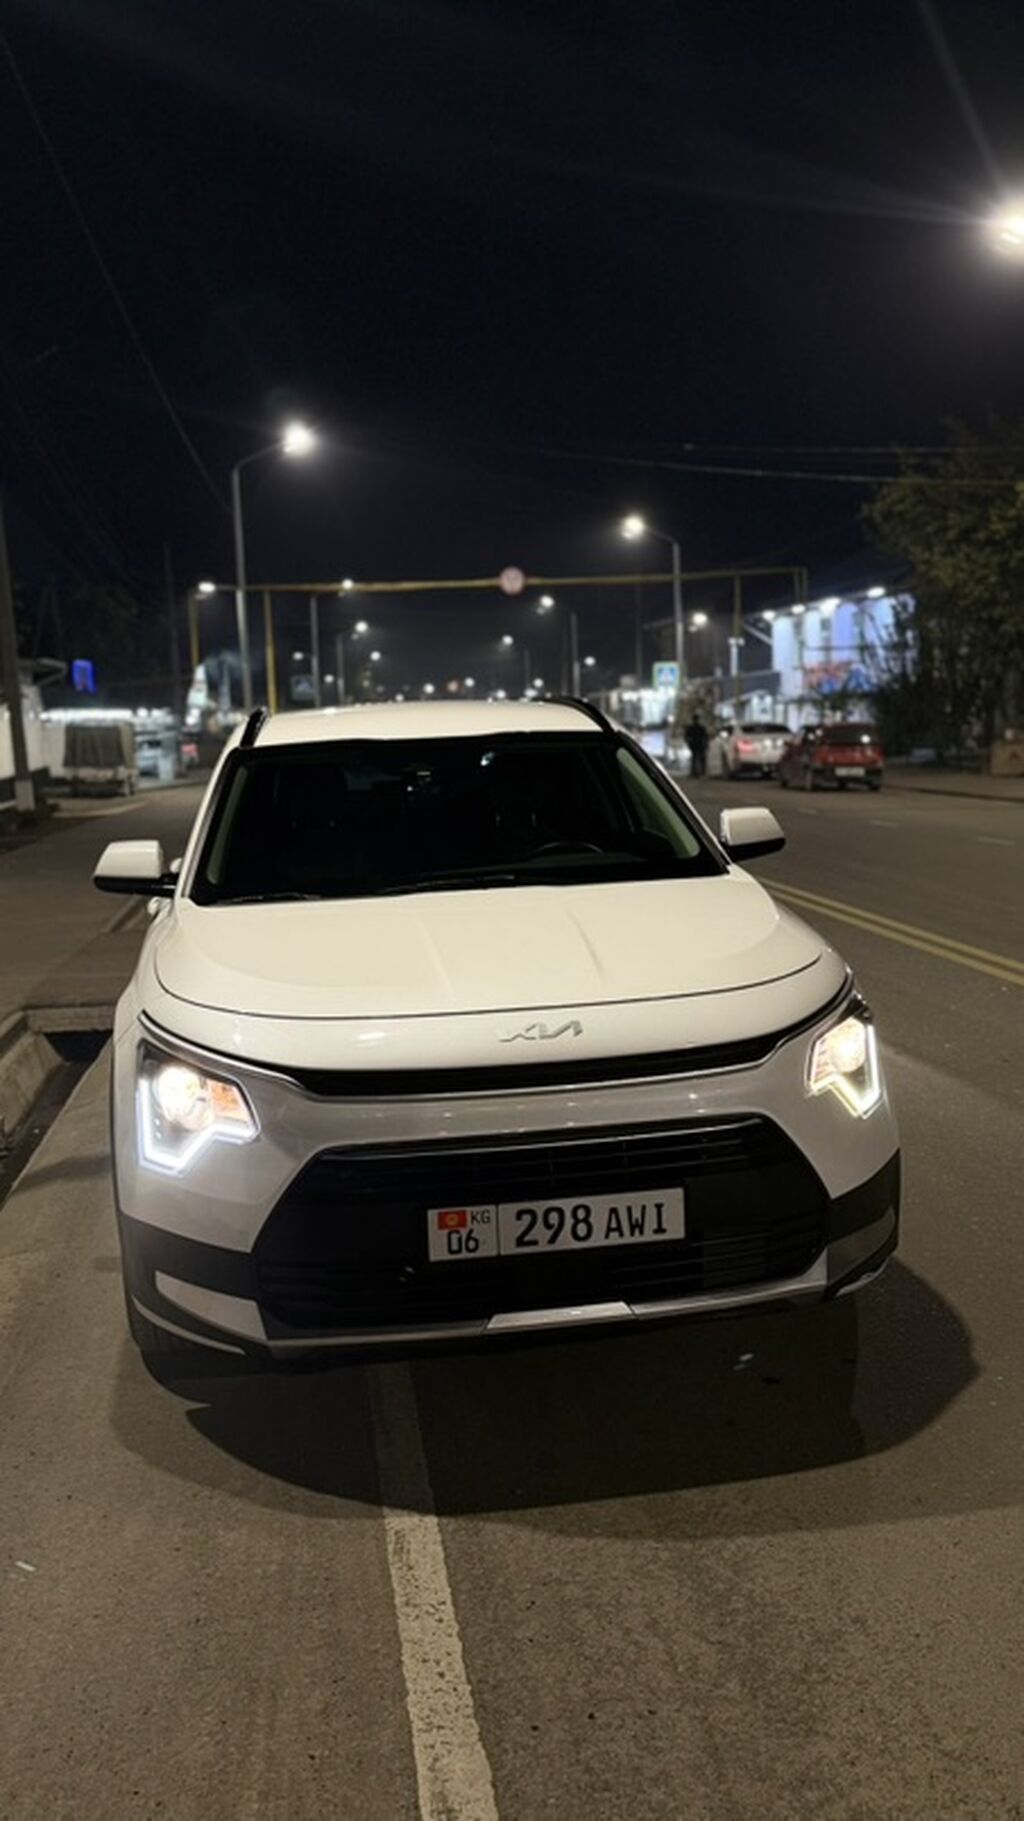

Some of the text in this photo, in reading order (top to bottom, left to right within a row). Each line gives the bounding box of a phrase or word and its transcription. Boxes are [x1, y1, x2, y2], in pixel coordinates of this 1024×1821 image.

[469, 1209, 491, 1225] KG
[514, 1202, 667, 1248] 298 AWI
[447, 1229, 480, 1255] 06
